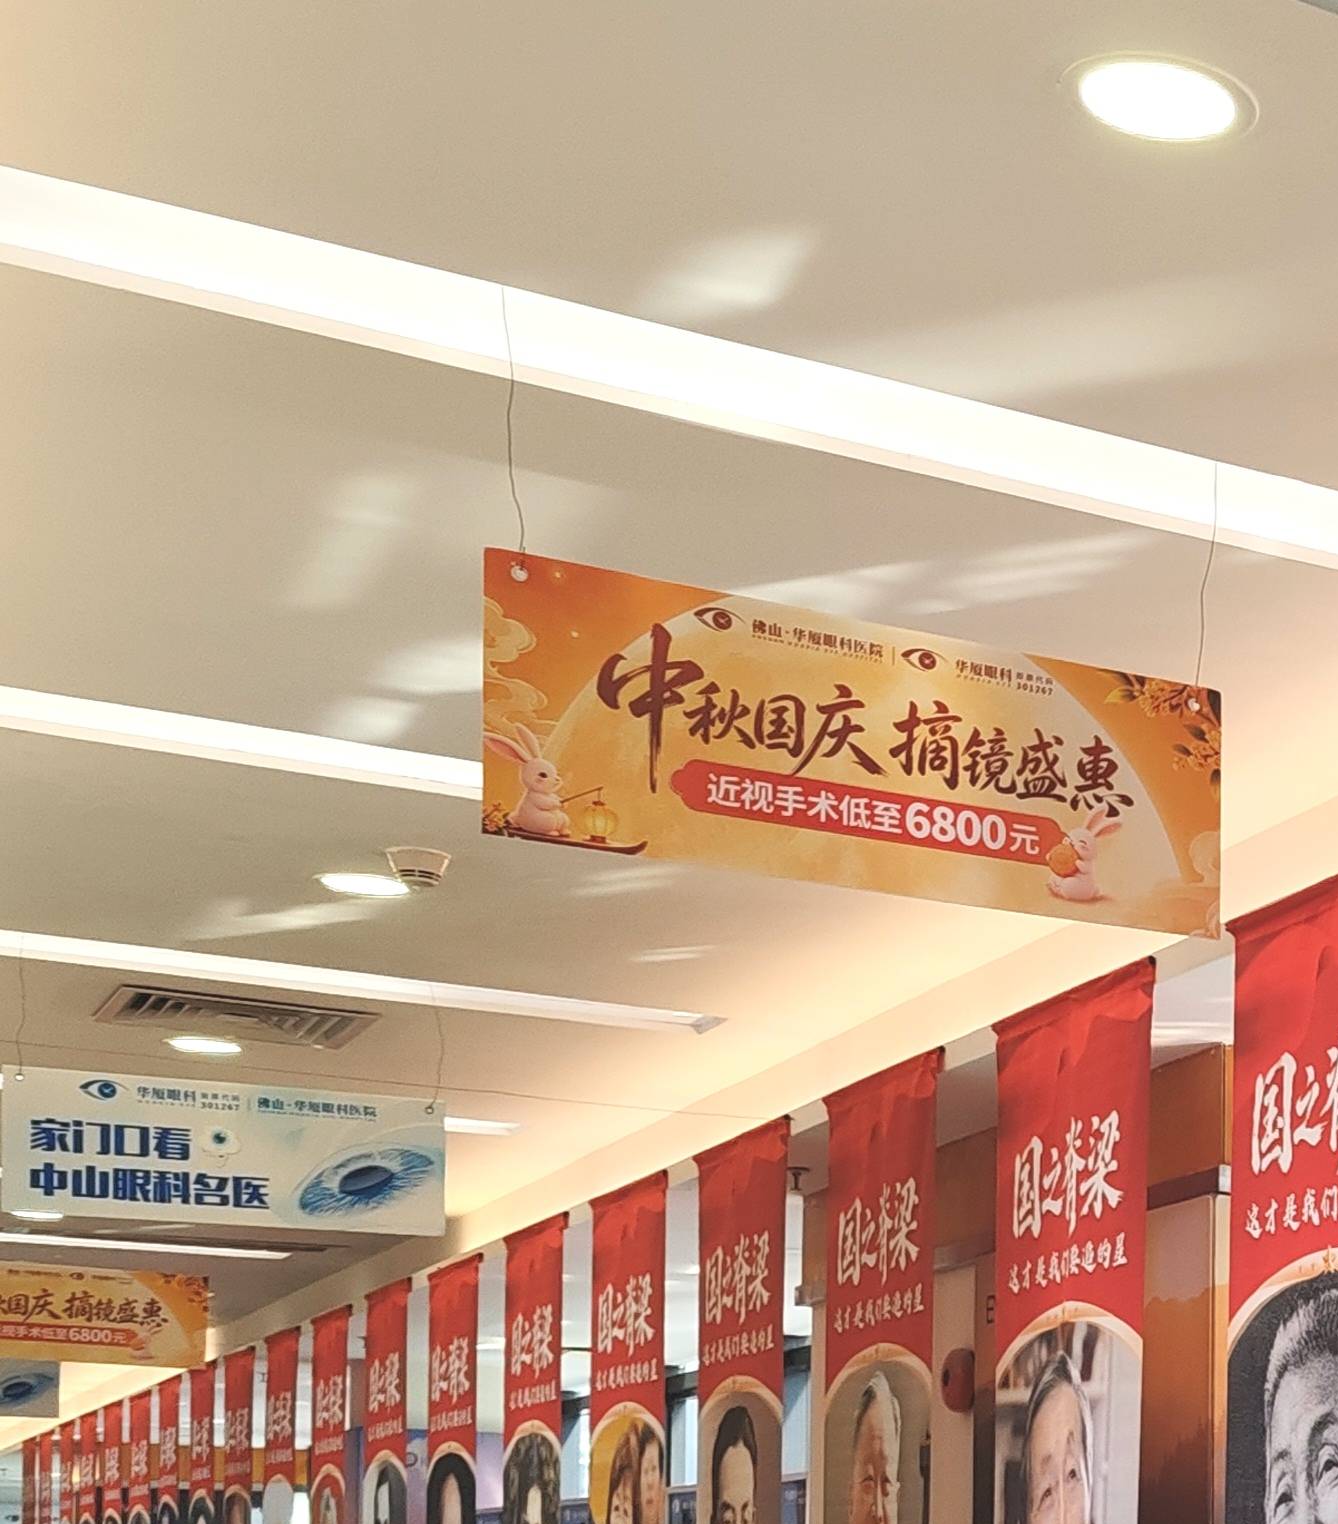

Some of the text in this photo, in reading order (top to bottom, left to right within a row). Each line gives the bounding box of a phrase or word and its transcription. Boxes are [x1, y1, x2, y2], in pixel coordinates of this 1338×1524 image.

[597, 623, 1134, 820] 中秋国庆 摘镜盛惠
[706, 772, 1040, 857] 近视手术低至6800元
[29, 1118, 192, 1162] 家门口看
[1013, 1110, 1124, 1239] 国之脊梁
[28, 1162, 271, 1210] 中山眼科名医
[837, 1177, 920, 1286] 国之脊梁
[0, 1288, 169, 1328] 国庆 摘镜盛惠
